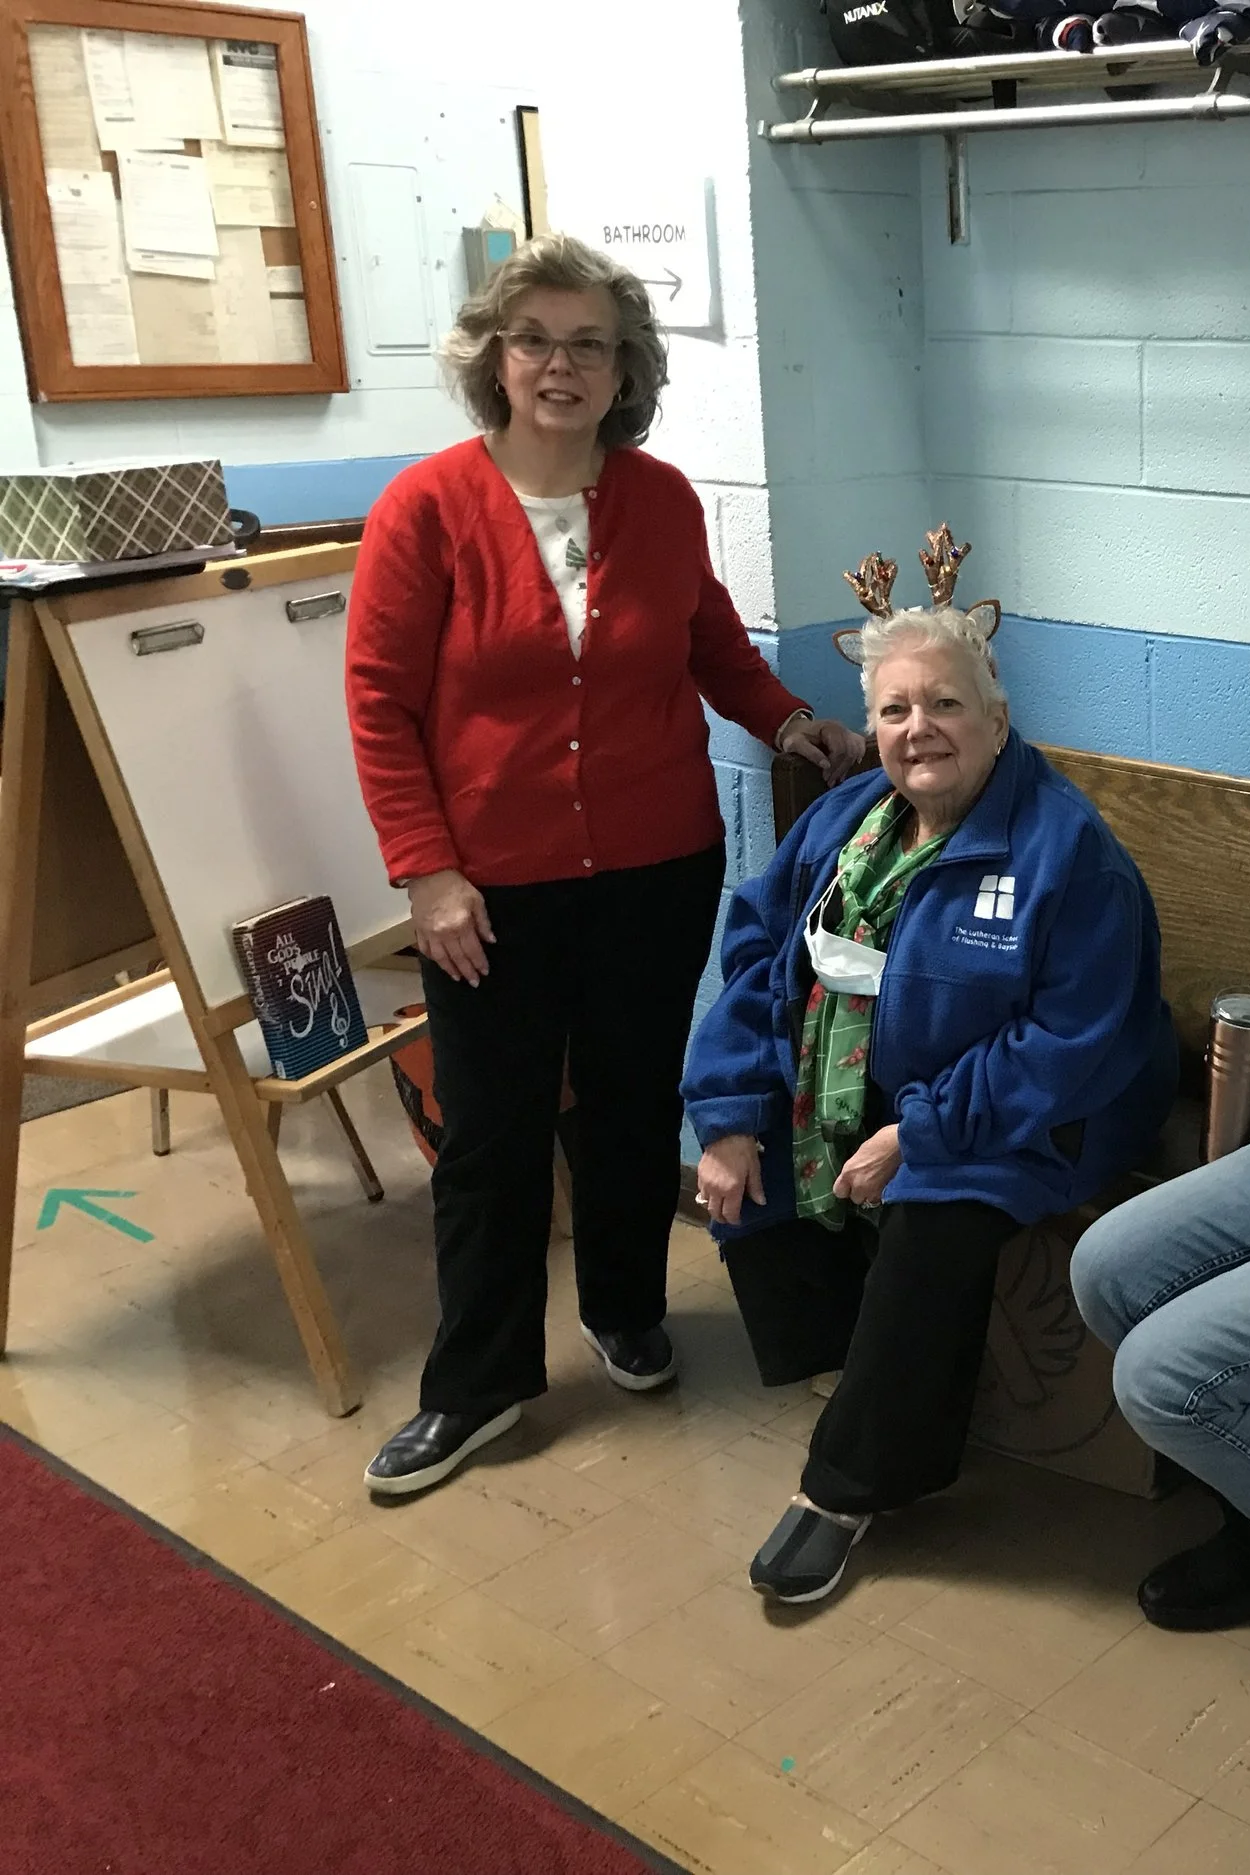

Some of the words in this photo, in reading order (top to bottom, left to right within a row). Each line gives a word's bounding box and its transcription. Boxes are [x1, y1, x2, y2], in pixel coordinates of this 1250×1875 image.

[843, 0, 888, 24] NUTANIX
[603, 224, 686, 244] BATHROOM
[955, 926, 967, 935] The
[968, 929, 1000, 940] Lutheran
